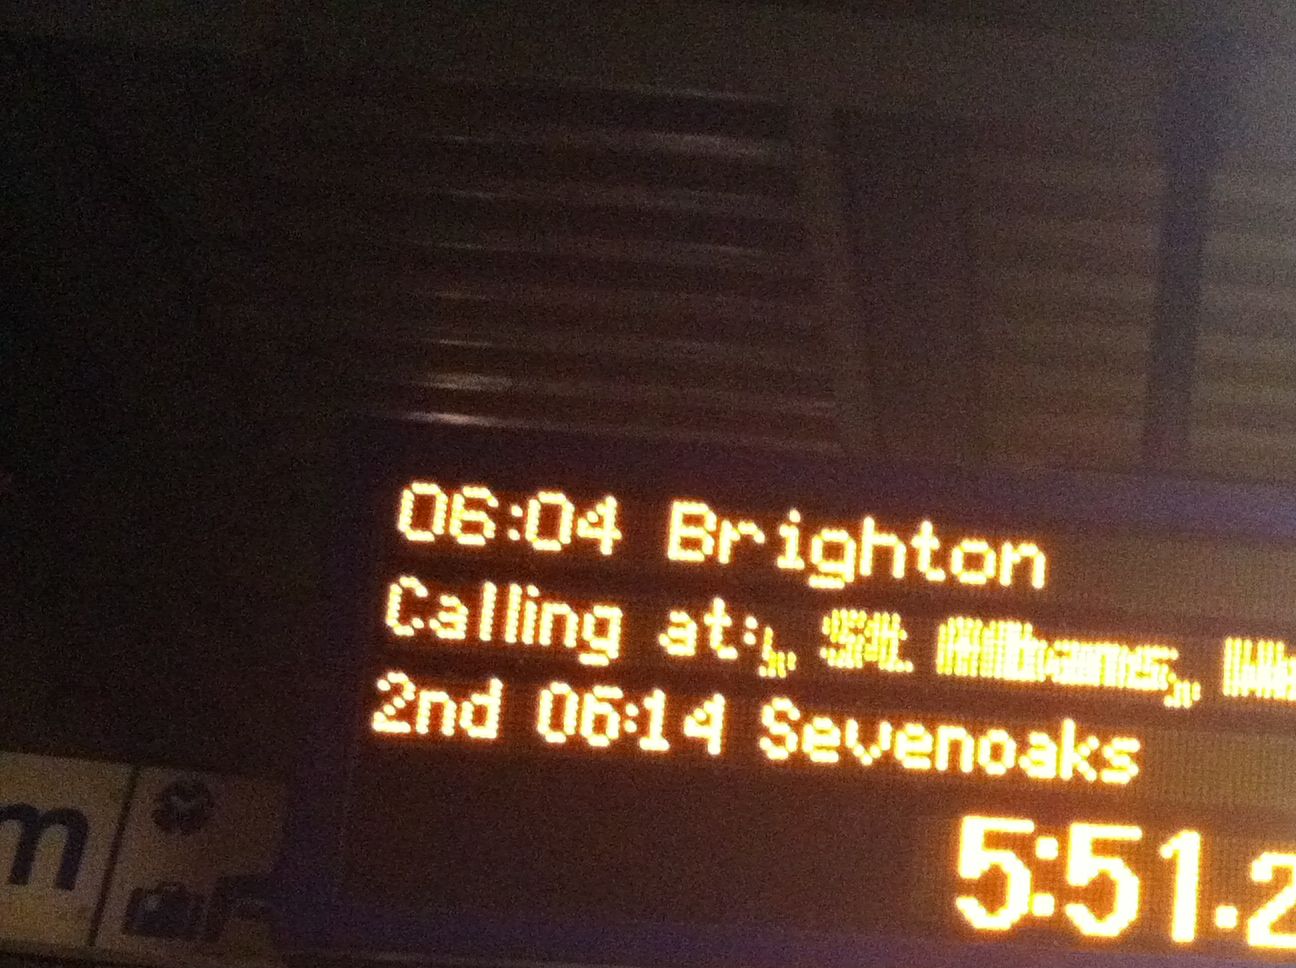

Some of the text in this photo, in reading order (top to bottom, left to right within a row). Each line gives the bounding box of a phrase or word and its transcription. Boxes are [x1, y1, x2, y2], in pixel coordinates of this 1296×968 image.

[397, 483, 1046, 589] 06:04 Brighton
[386, 576, 623, 666] Calling
[371, 672, 1140, 784] 2nd 06:14 Sevenoaks
